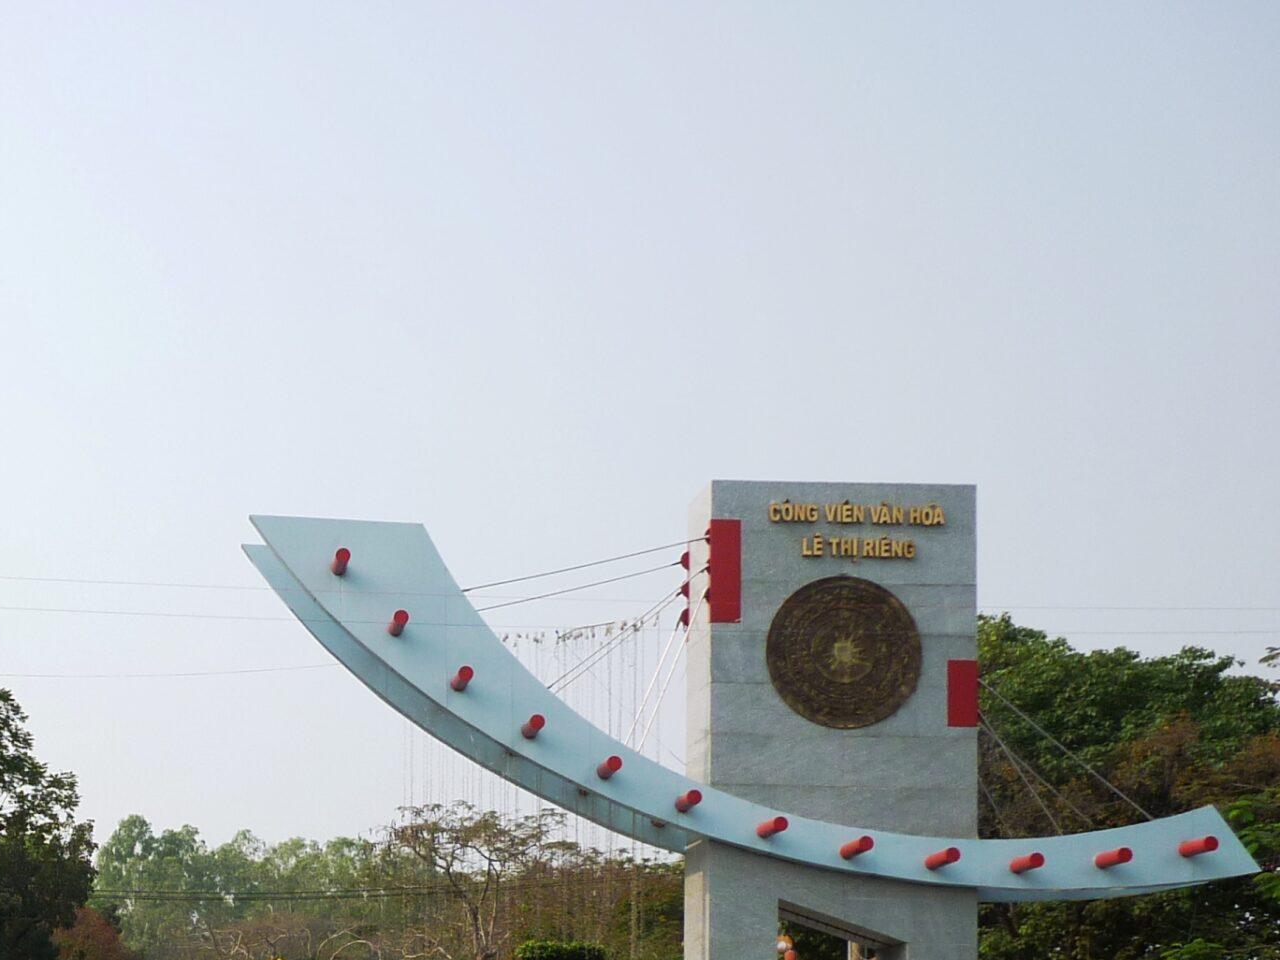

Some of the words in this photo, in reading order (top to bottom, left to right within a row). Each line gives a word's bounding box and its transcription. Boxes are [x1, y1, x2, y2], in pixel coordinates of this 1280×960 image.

[768, 499, 819, 522] CÔNG
[824, 500, 865, 523] VIÊN
[870, 501, 904, 524] VĂN
[801, 533, 824, 556] LÊ
[828, 536, 859, 562] THỊ
[863, 535, 916, 559] RIÊNG
